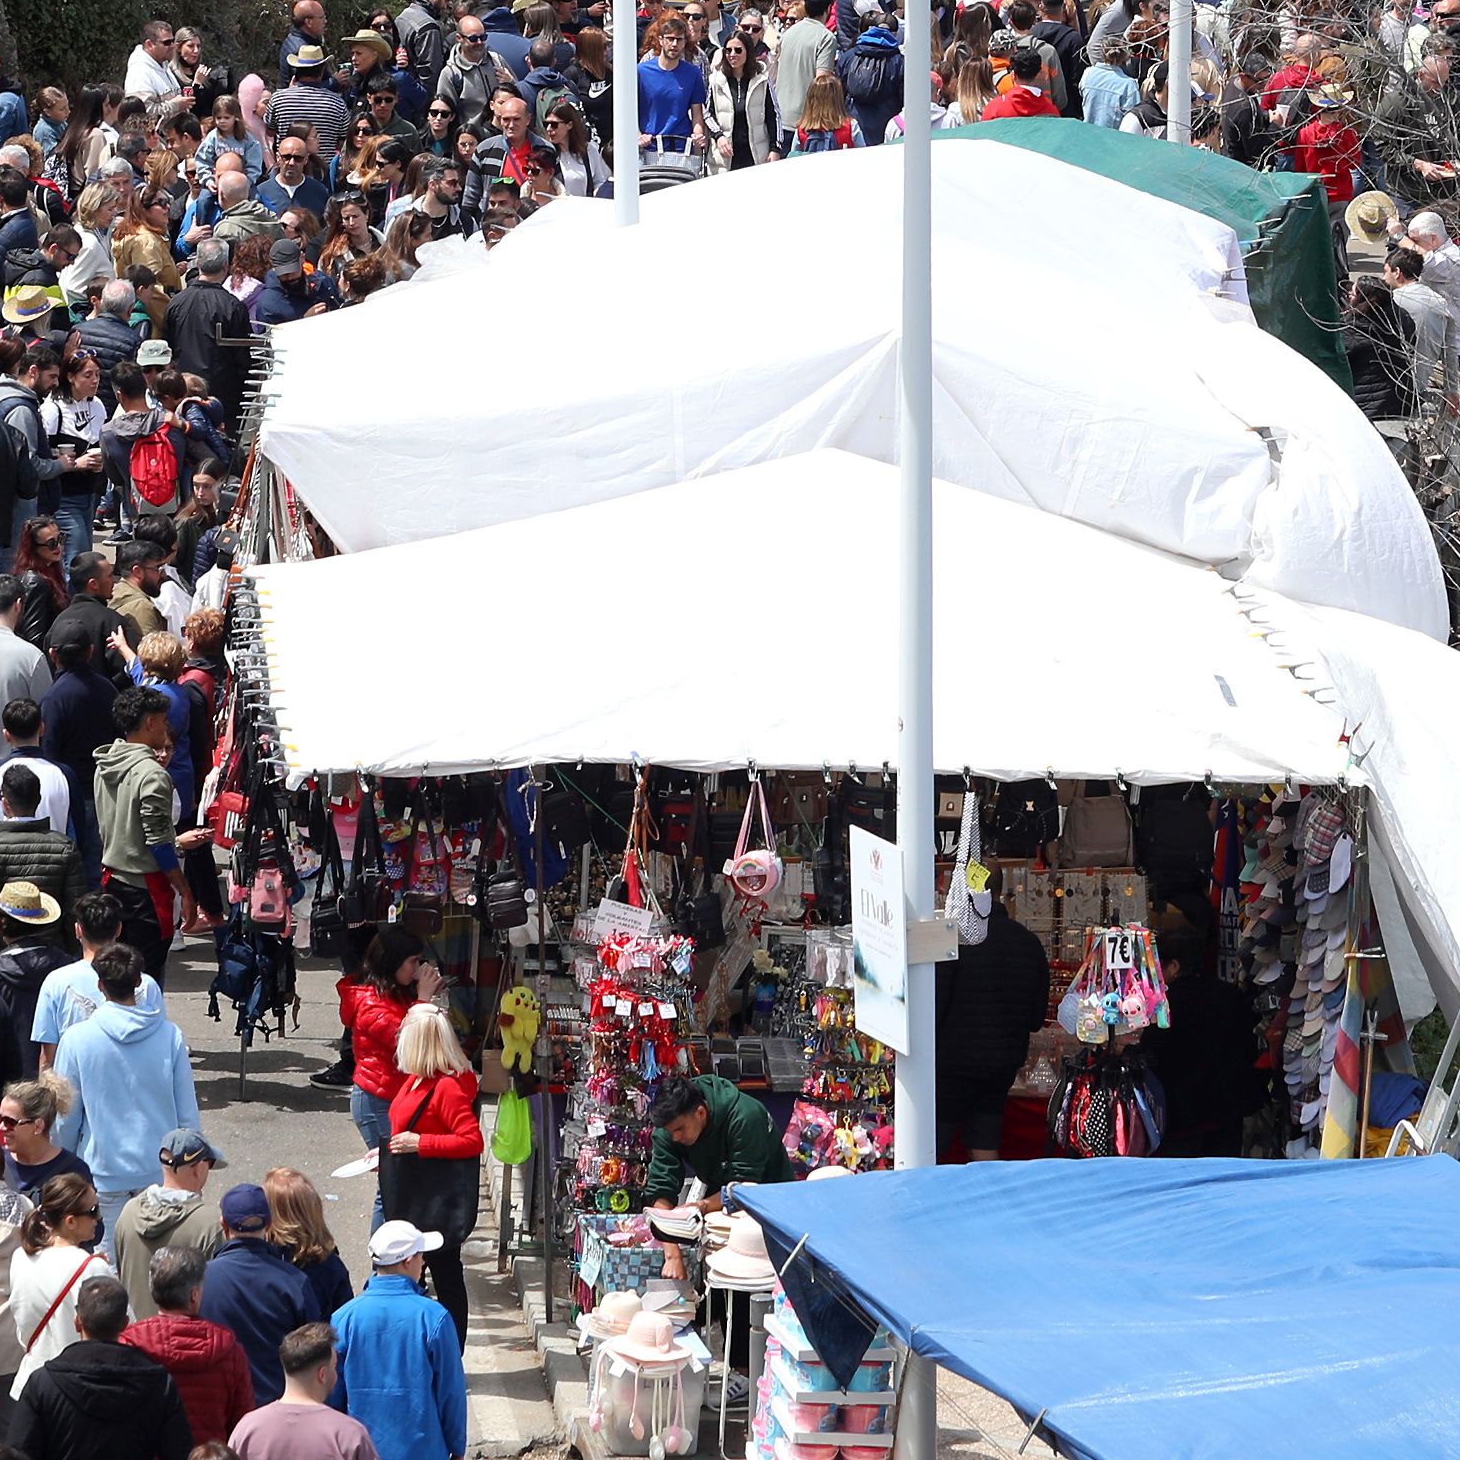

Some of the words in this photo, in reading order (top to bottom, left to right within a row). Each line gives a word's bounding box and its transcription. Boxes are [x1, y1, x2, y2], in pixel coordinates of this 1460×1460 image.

[971, 873, 980, 889] 5
[860, 888, 870, 919] El
[870, 893, 894, 930] Valle
[1107, 936, 1130, 964] 7€
